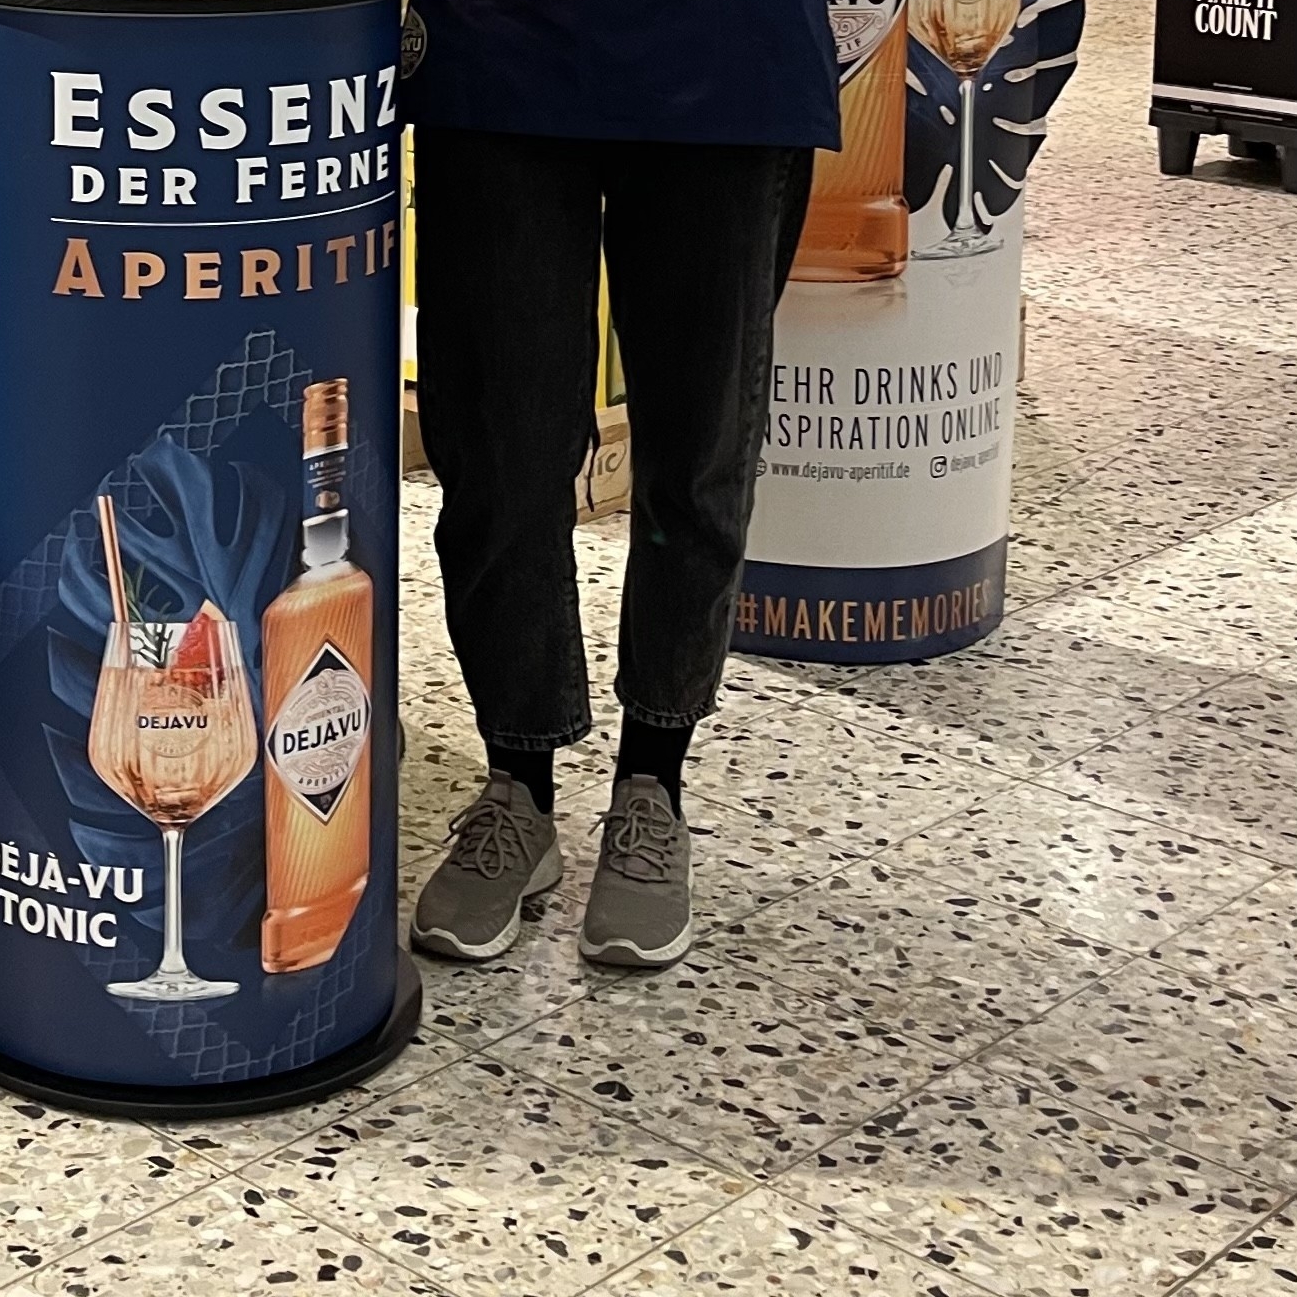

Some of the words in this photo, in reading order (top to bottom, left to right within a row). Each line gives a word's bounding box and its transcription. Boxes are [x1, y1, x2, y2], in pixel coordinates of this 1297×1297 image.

[1195, 3, 1278, 41] COUNT
[50, 64, 397, 151] ESSENZ
[70, 164, 197, 206] DER
[235, 143, 390, 204] FERNE
[52, 219, 396, 301] APERITIF
[773, 365, 834, 405] EHR
[855, 362, 957, 405] DRINKS
[969, 352, 1002, 394] UND
[764, 412, 928, 450] NSPIRATION
[941, 397, 1000, 444] ONLINE
[771, 461, 910, 482] www.dejavu-aperitif.de
